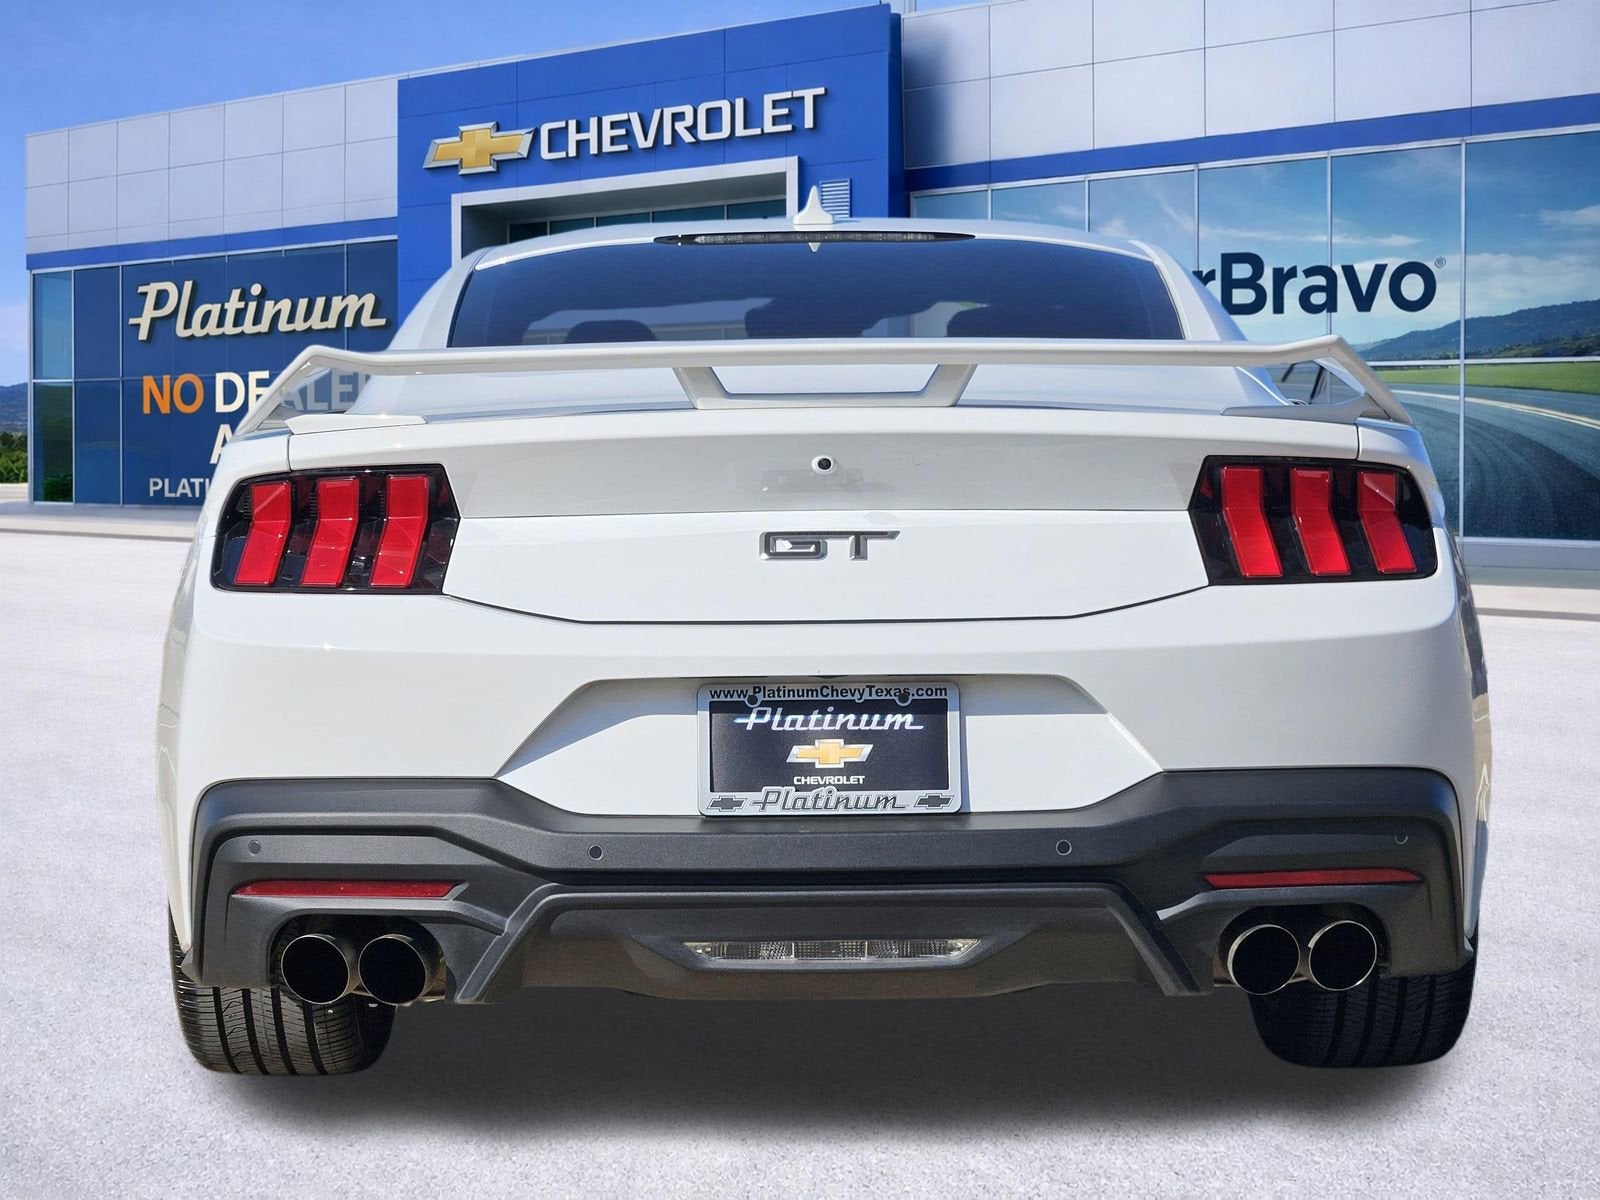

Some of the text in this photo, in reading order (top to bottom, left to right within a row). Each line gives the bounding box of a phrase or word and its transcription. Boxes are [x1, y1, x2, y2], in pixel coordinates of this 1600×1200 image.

[540, 87, 826, 161] CHEVROLET
[129, 280, 387, 341] Platinum
[143, 373, 205, 414] NO
[759, 531, 900, 561] GT
[709, 685, 948, 699] www.PlatinumChevyTexas.com
[734, 706, 924, 731] Platinum
[793, 775, 865, 785] CHEVROLET
[750, 789, 910, 812] Platinum
